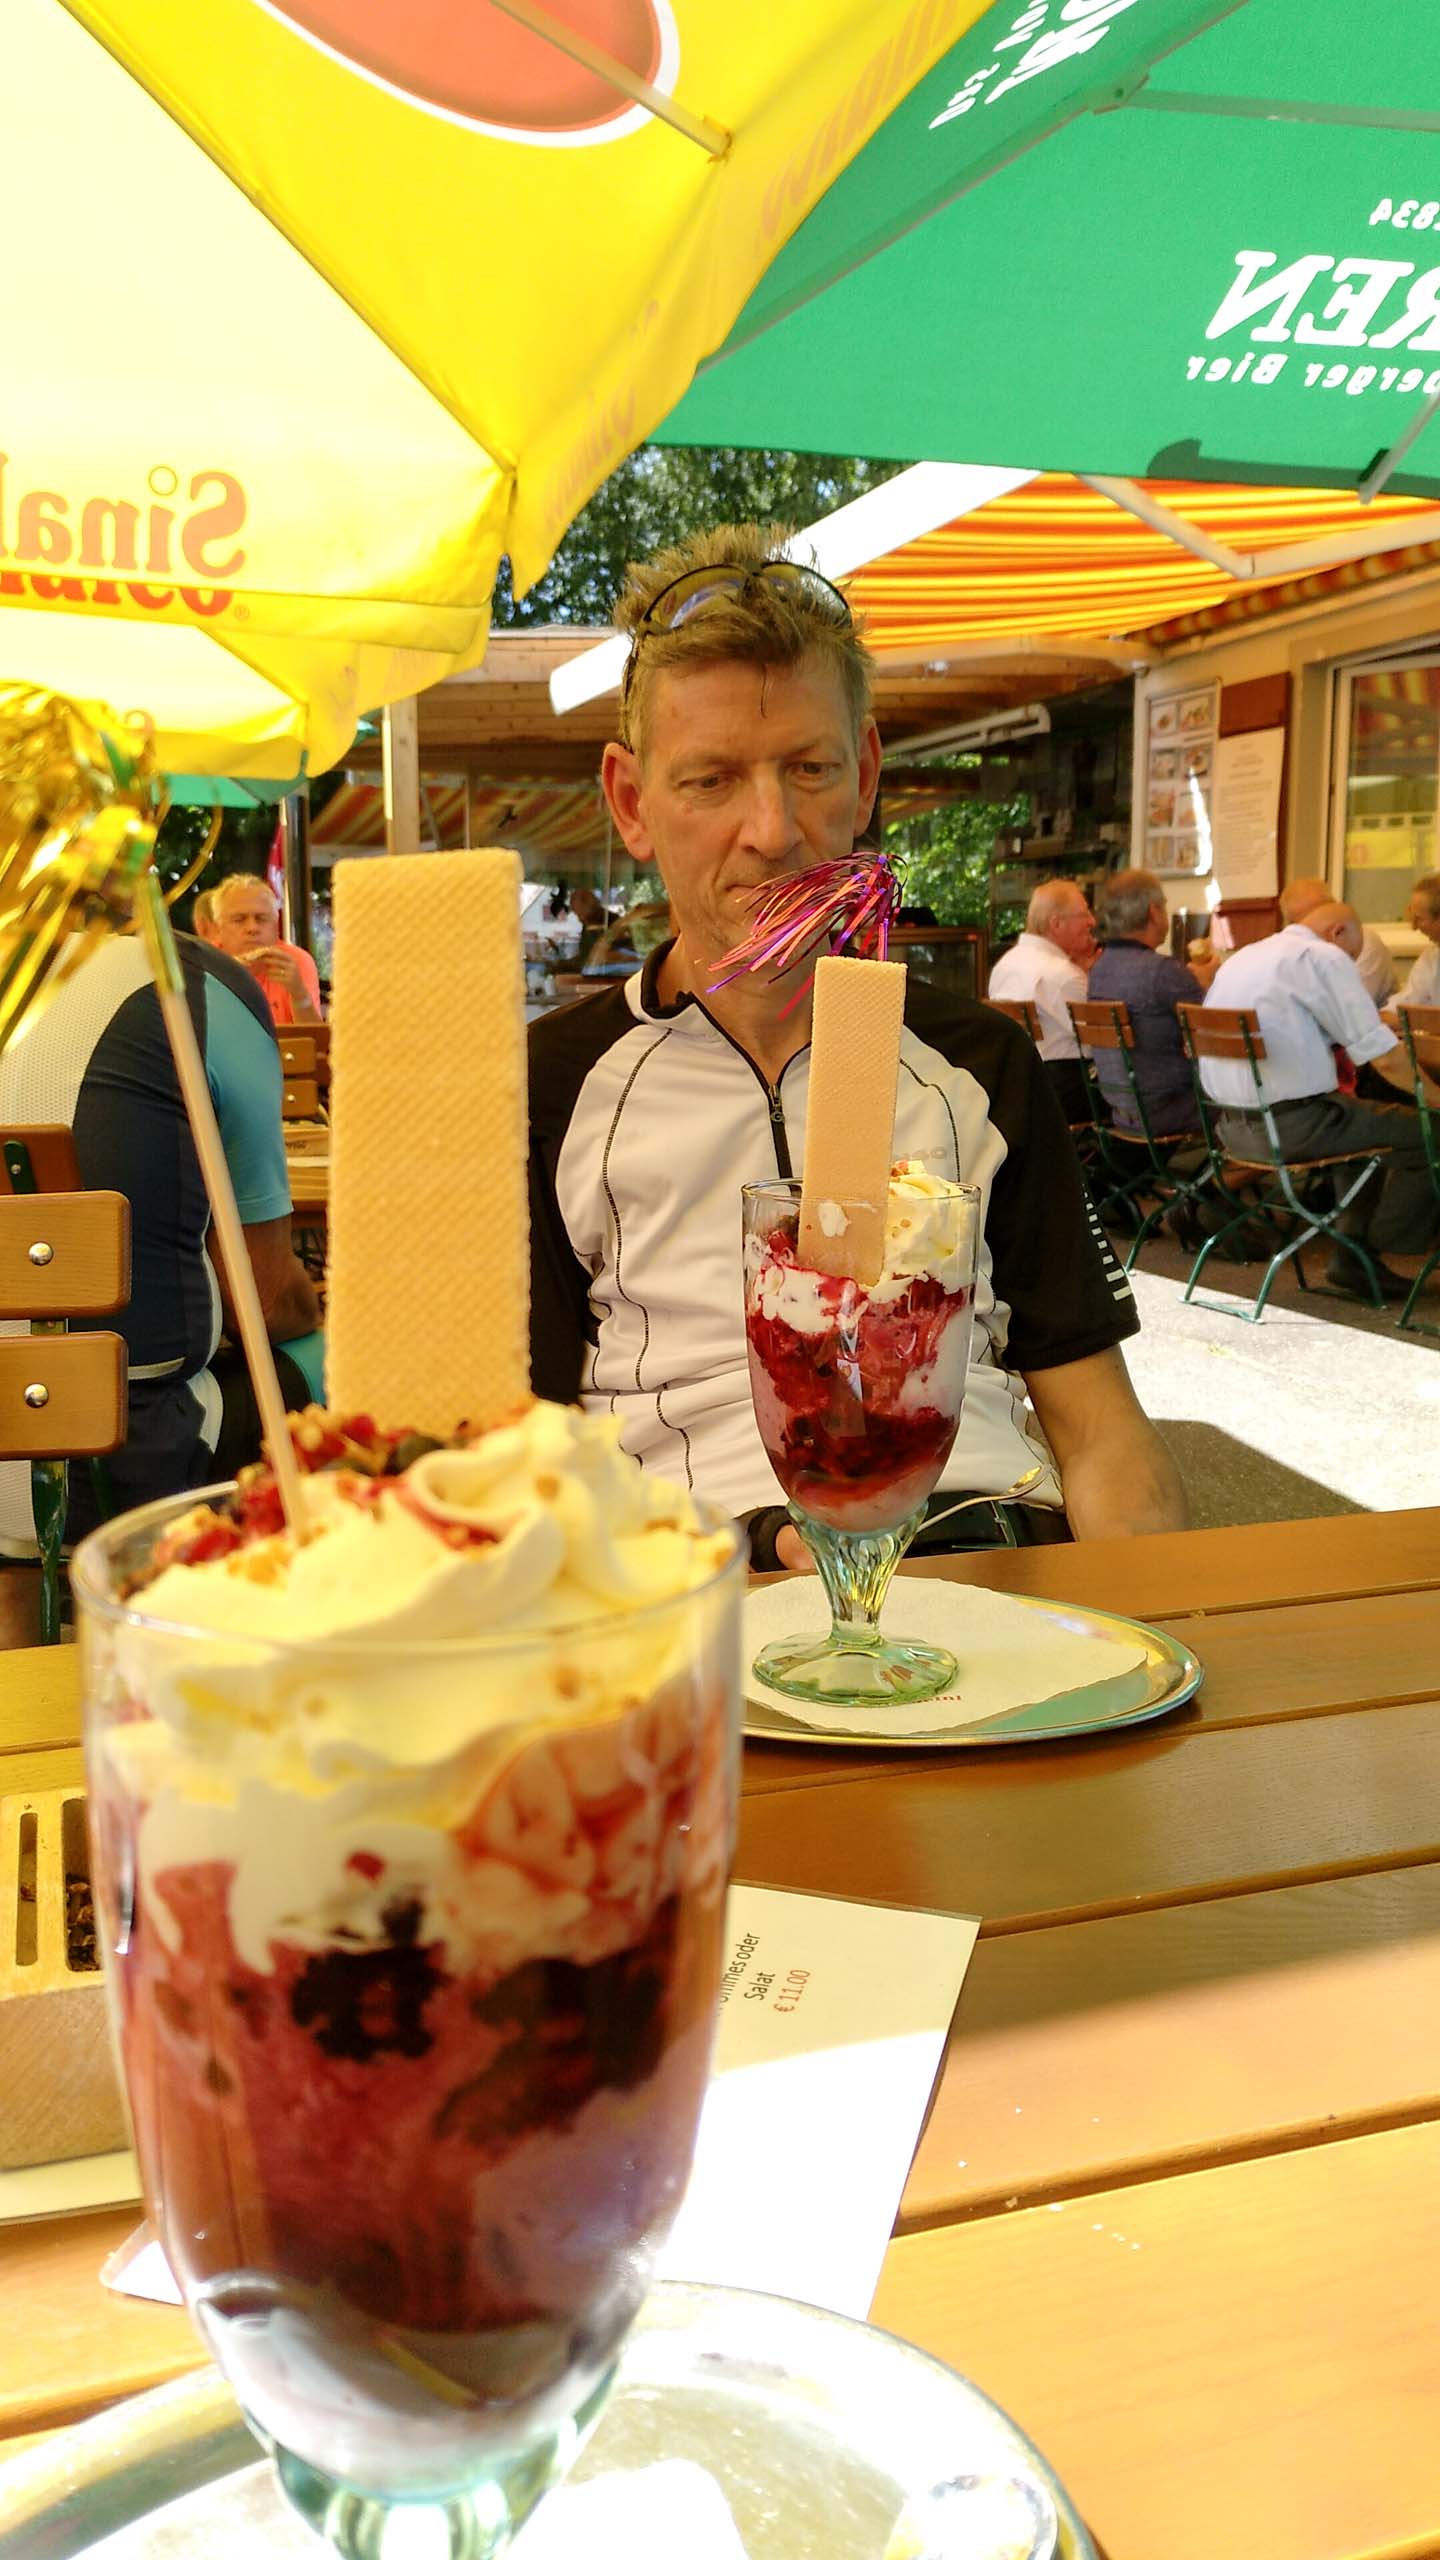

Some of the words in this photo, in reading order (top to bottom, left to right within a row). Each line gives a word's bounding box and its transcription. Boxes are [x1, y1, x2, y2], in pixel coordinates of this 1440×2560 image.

[718, 1960, 747, 2011] ommes
[734, 1932, 761, 1960] oder
[743, 1971, 776, 2001] Salat
[778, 1969, 811, 2002] 11.00
